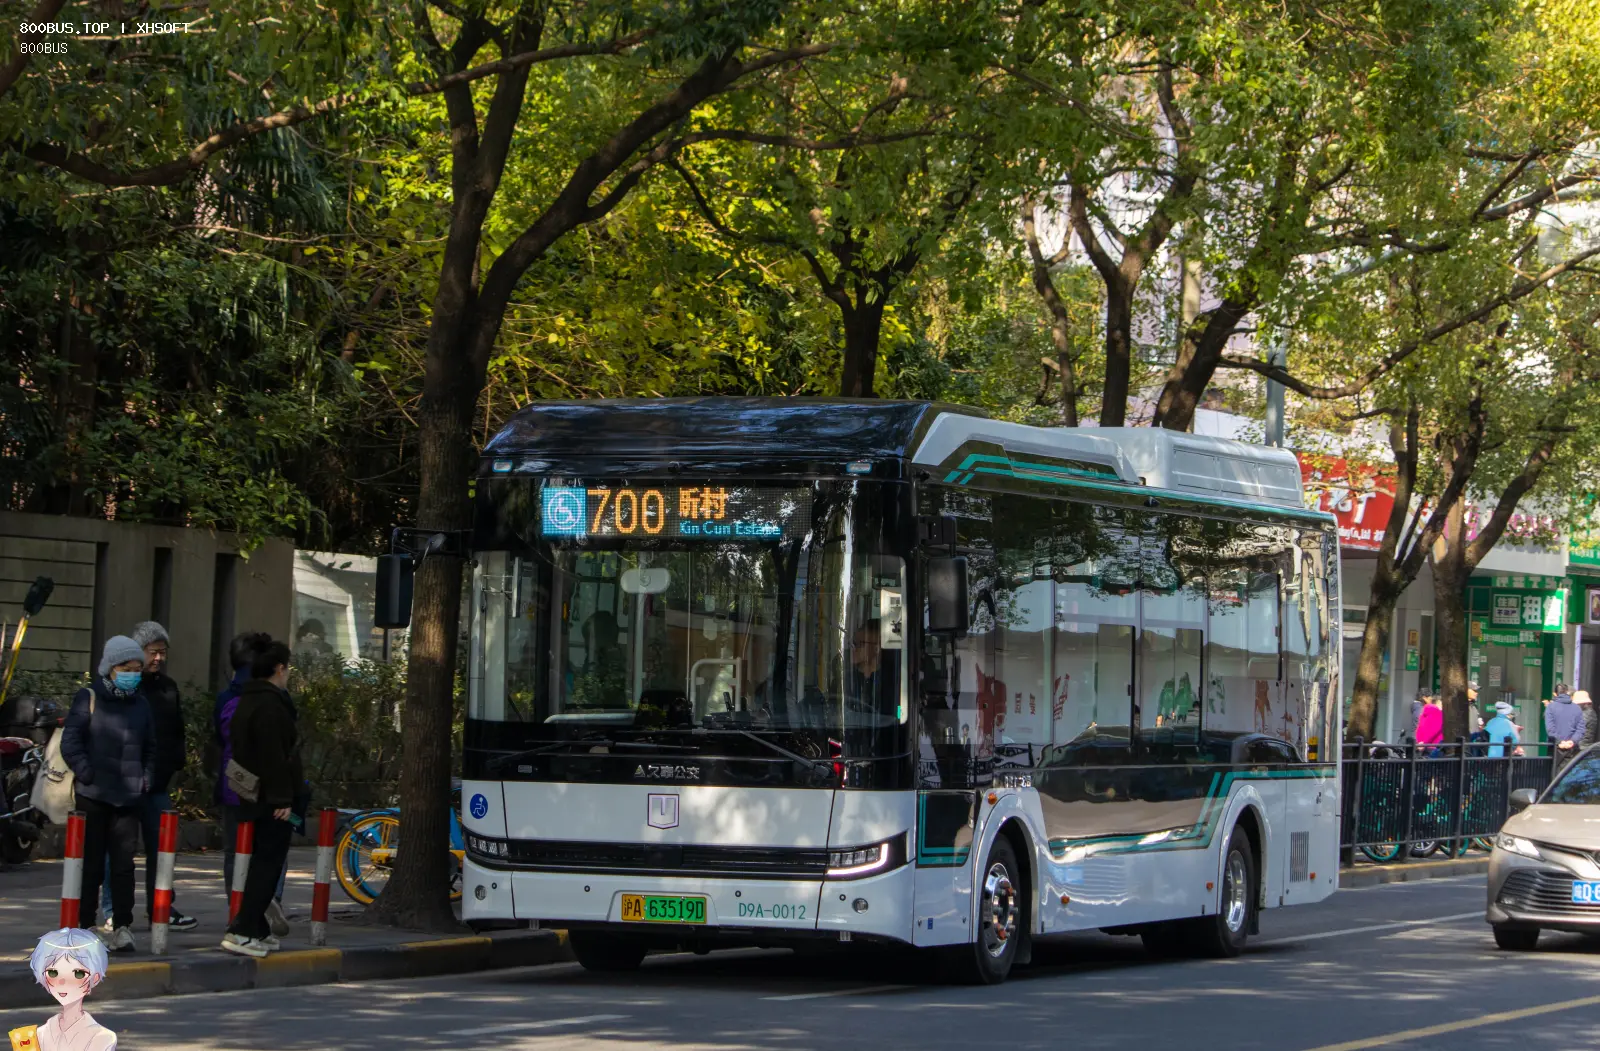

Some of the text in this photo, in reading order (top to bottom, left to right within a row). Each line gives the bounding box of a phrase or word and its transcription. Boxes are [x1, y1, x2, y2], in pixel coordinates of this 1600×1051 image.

[587, 489, 665, 534] 700
[703, 521, 730, 537] Cun
[734, 521, 781, 537] Estate
[649, 899, 705, 920] 63519D
[738, 902, 806, 920] D9A-0012
